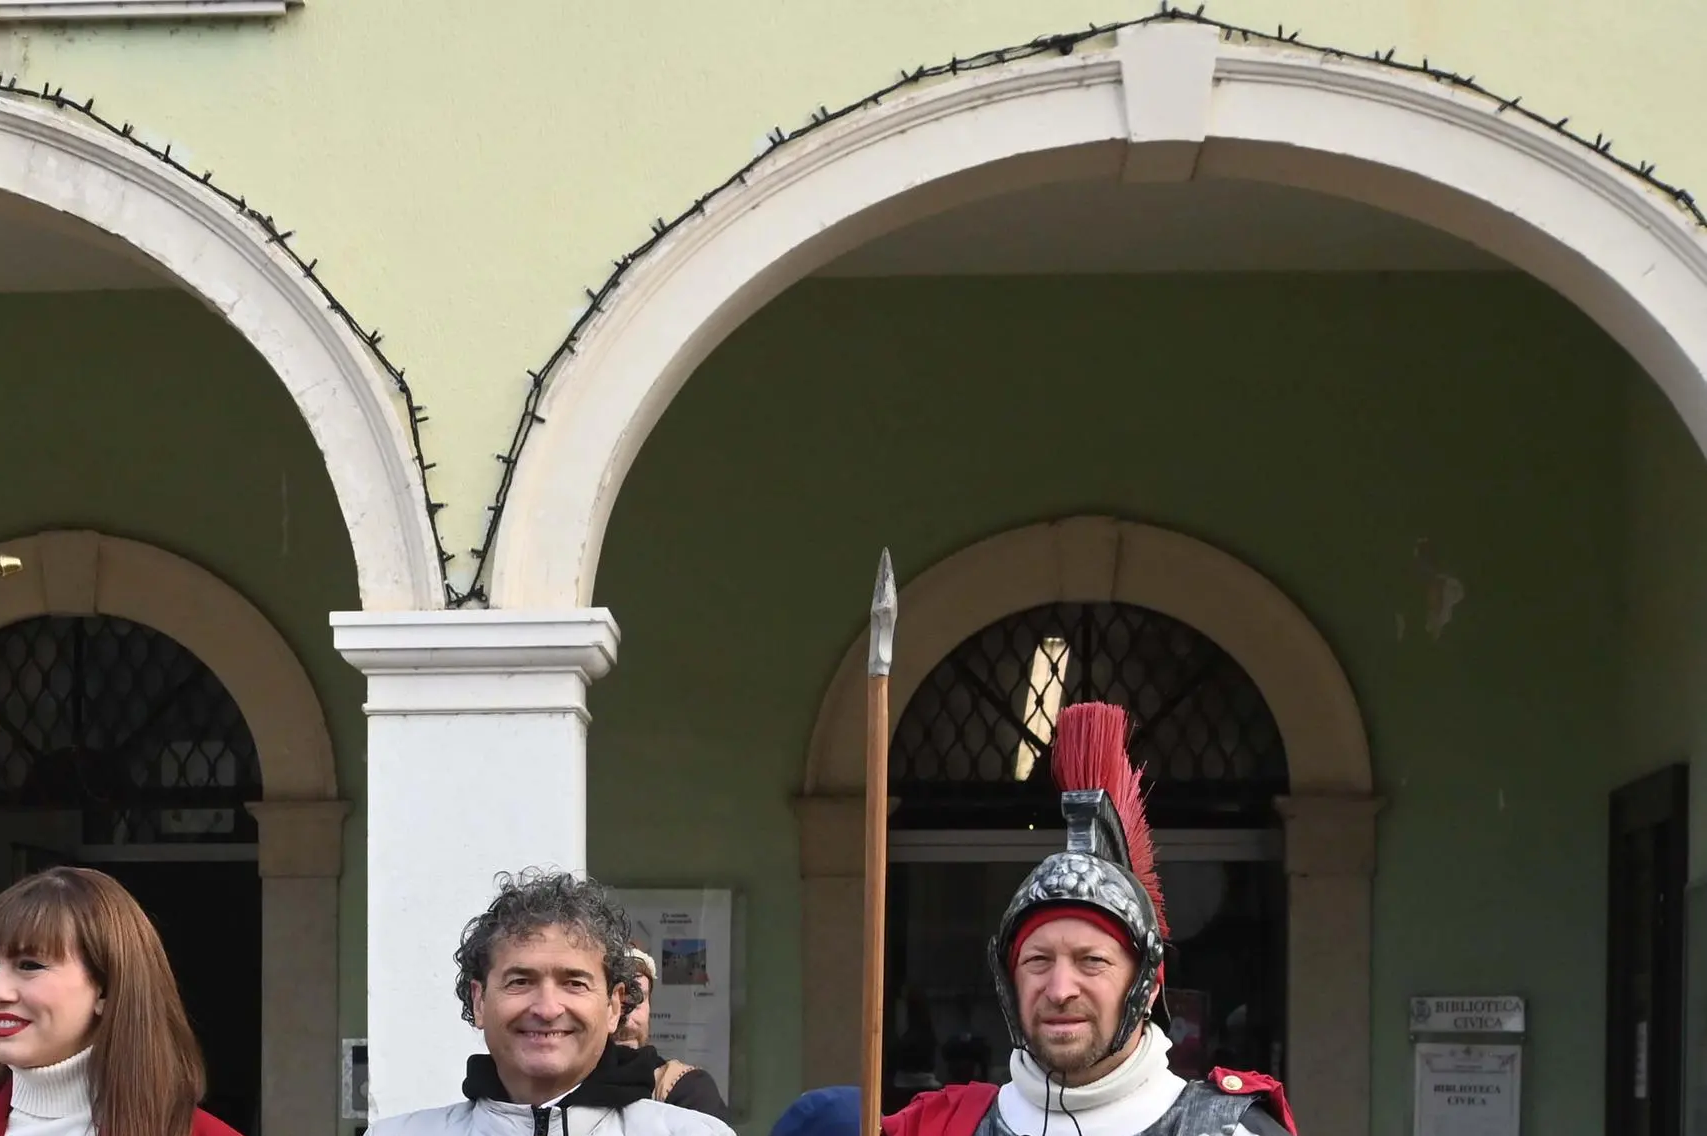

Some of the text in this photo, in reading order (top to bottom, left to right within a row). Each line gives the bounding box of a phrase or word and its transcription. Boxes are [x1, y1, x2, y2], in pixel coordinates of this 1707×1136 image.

[1435, 1000, 1522, 1014] BIBLIOTECA
[1453, 1015, 1503, 1029] CIVICA
[1433, 1083, 1502, 1095] BIBLIOTECA
[1447, 1096, 1487, 1107] CIVICA
